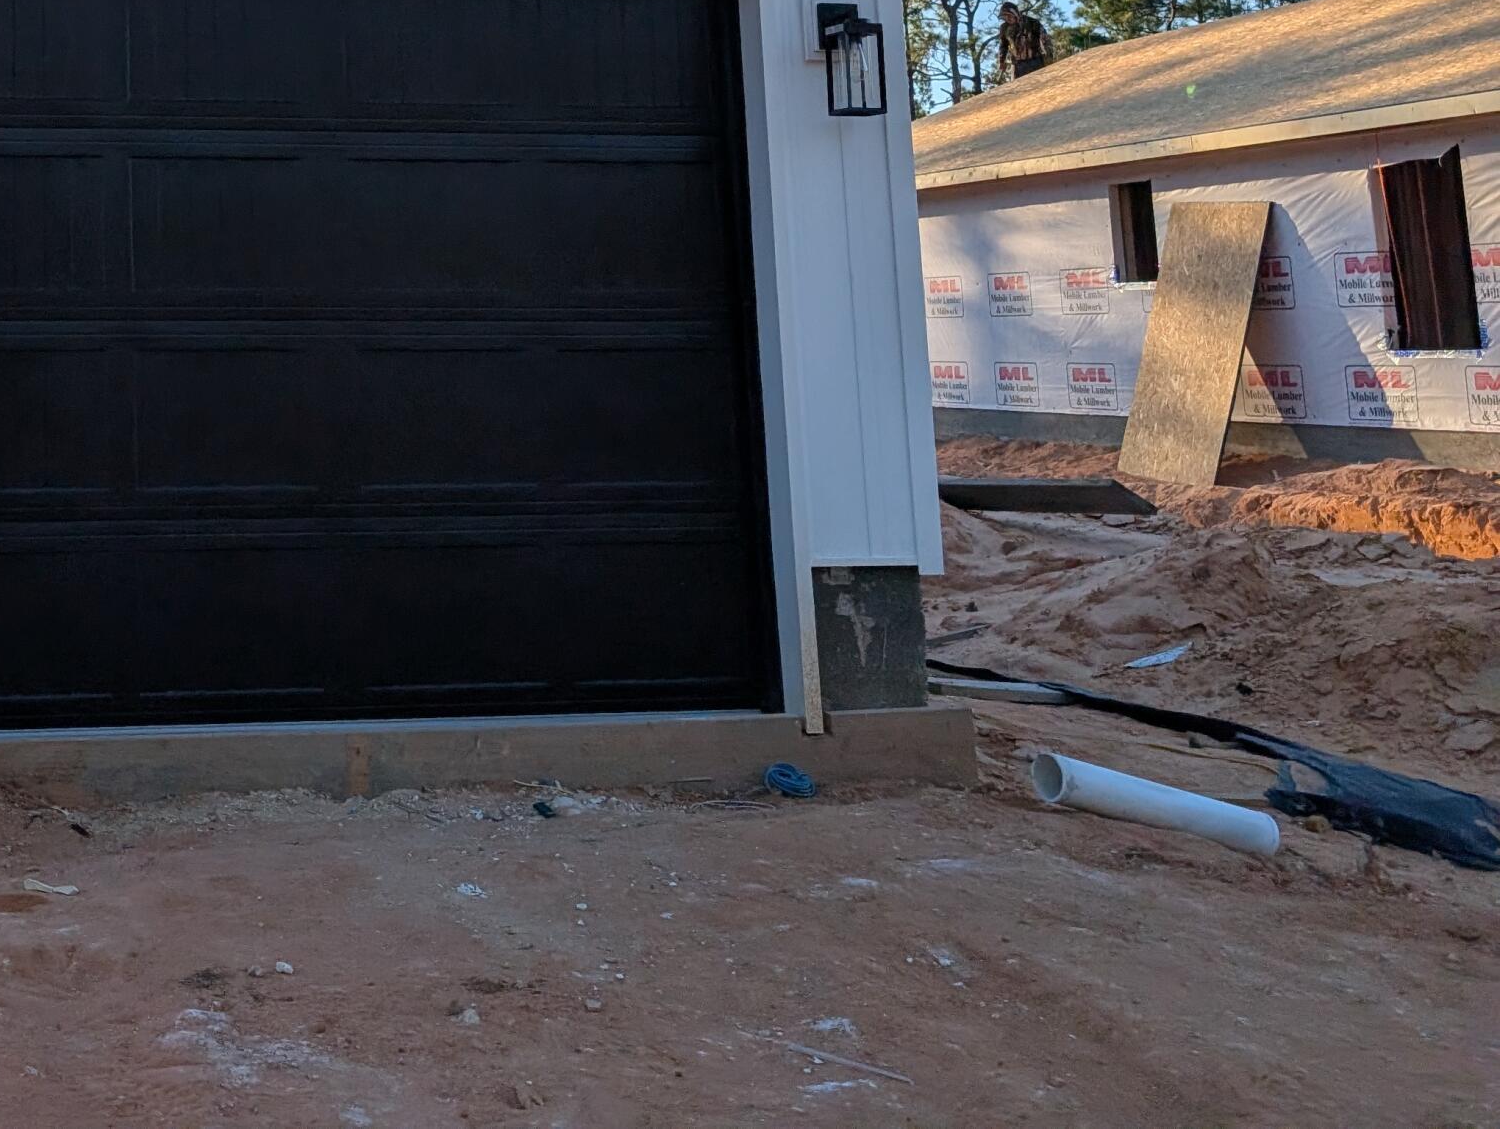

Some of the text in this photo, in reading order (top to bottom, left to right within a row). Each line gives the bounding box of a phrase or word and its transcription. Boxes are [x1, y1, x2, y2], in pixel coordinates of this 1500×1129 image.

[929, 279, 961, 294] ML
[994, 276, 1029, 291] ML
[1065, 272, 1106, 288] ML
[1339, 278, 1367, 290] Mobile
[1357, 292, 1396, 304] Millwor
[933, 365, 966, 380] ML
[998, 366, 1034, 381] ML
[1072, 367, 1112, 383] ML
[1247, 371, 1298, 388] ML
[1352, 370, 1411, 389] ML
[997, 382, 1015, 392] Mobile
[1070, 383, 1117, 395] Mobile Lumber
[1245, 389, 1303, 401] Mobile Lumber
[1350, 391, 1416, 403] Mobile Lumber
[1083, 398, 1111, 407] Millwork
[1261, 404, 1297, 415] Millwork
[1358, 405, 1408, 418] & Millwork
